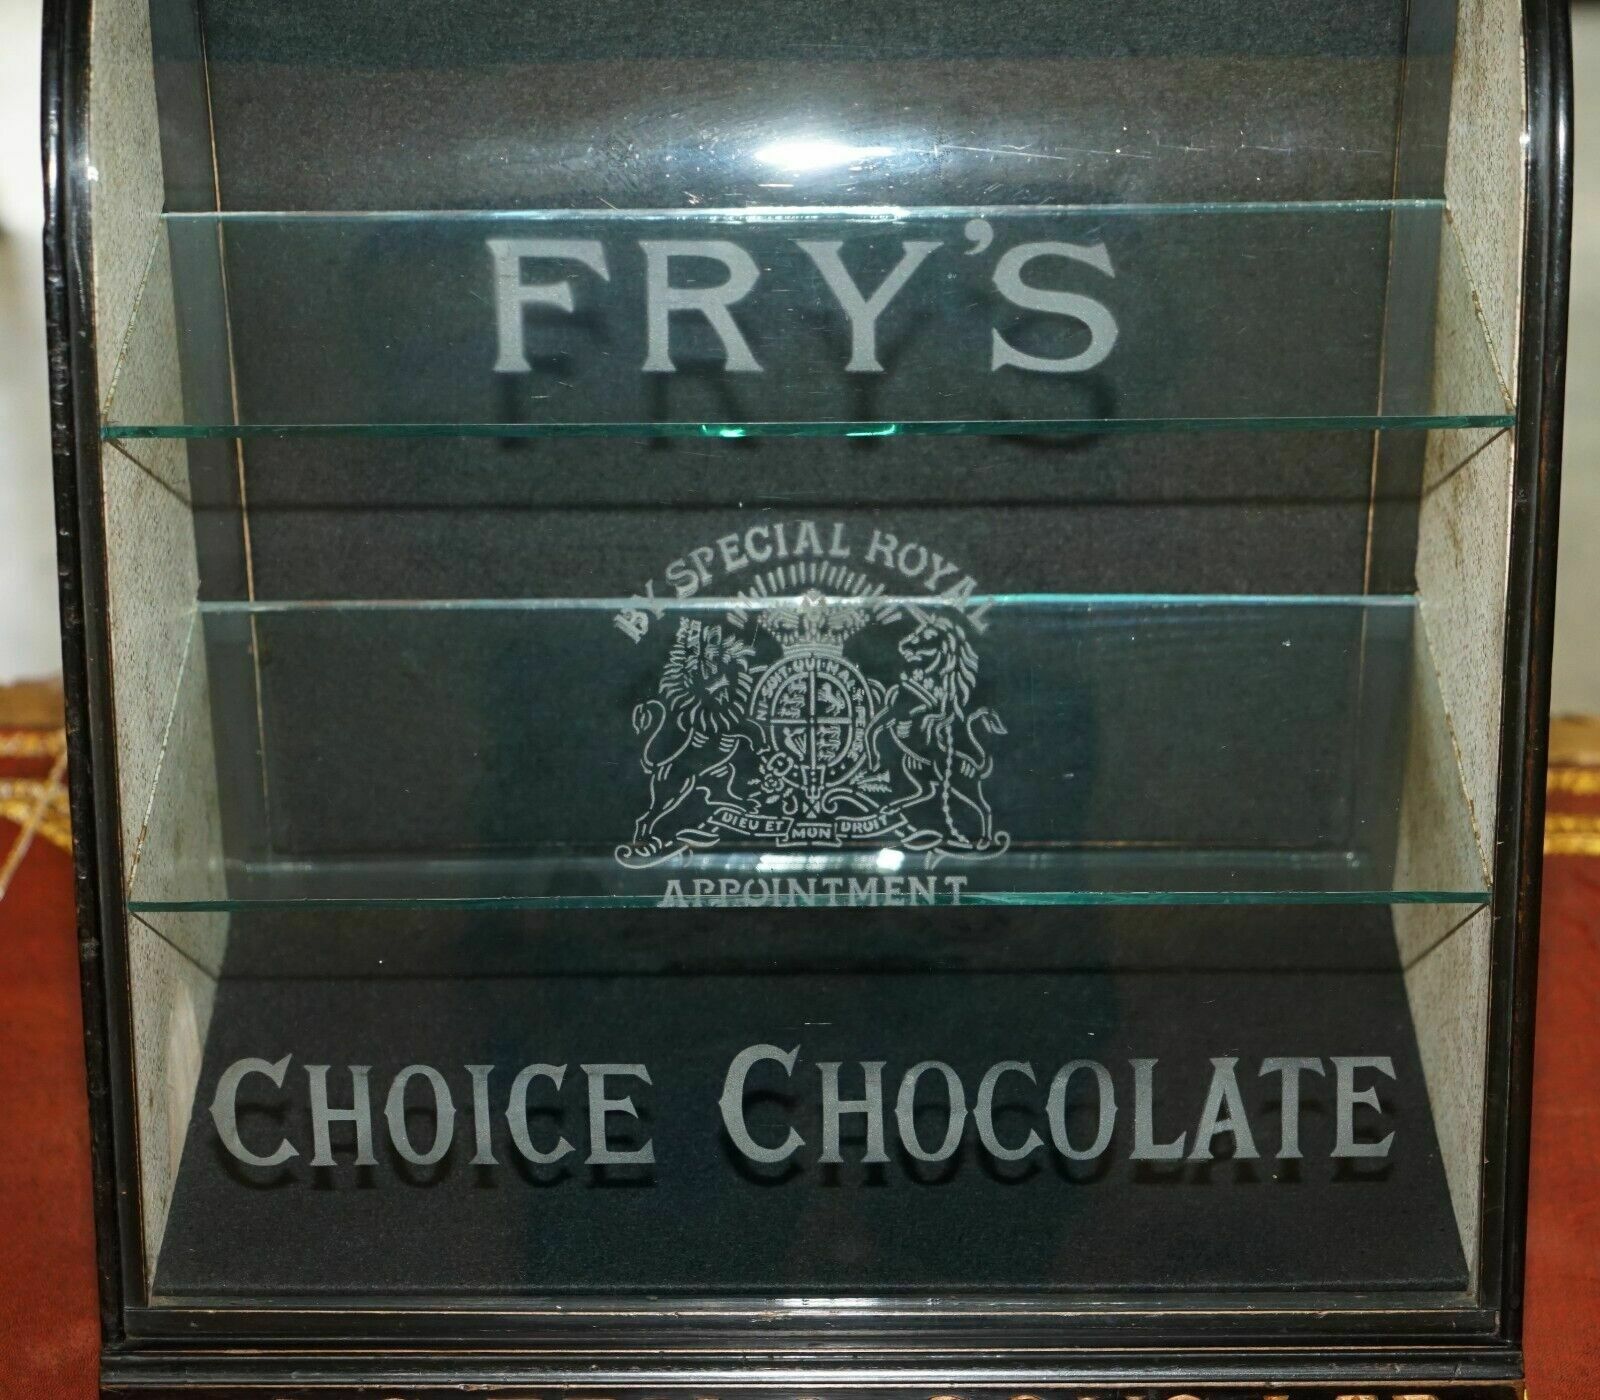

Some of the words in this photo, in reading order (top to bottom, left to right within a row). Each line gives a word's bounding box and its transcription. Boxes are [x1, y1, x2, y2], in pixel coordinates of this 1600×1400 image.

[486, 219, 1117, 373] FRY'S
[613, 579, 665, 644] BY
[665, 520, 850, 600] SPECIAL
[864, 530, 1002, 635] ROYAL
[721, 812, 759, 831] DIEU
[765, 820, 784, 832] ET
[657, 876, 967, 907] APPOINTMENT
[209, 1053, 655, 1166] CHOICE
[718, 1044, 1397, 1163] CHOCOLATE
